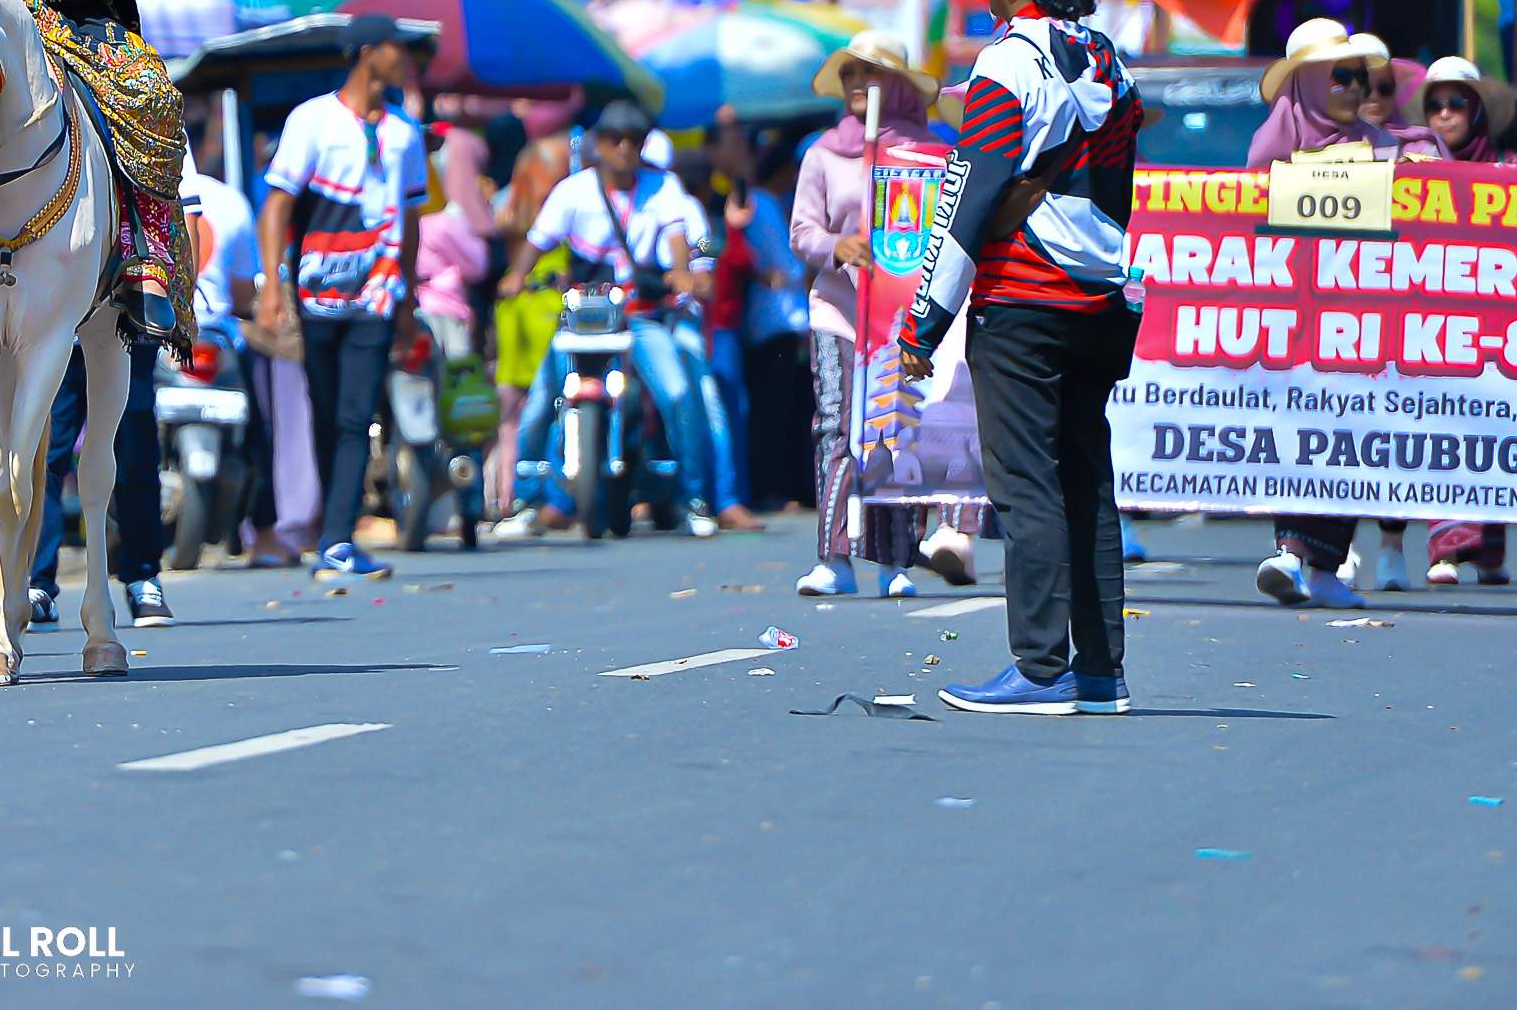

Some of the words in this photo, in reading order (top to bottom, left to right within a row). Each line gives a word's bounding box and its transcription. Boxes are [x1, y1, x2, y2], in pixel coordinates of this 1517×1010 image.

[1312, 171, 1349, 180] DESA
[1297, 194, 1361, 220] 009
[1318, 239, 1517, 296] KEMER
[1176, 305, 1298, 358] HUT
[1318, 311, 1381, 362] RI
[1145, 382, 1278, 412] Berdaulat,
[1286, 387, 1376, 417] Rakyat
[1384, 388, 1517, 422] Sejahtera,
[1151, 422, 1282, 465] DESA
[1120, 472, 1258, 496] KECAMATAN
[1264, 477, 1380, 501] BINANGUN
